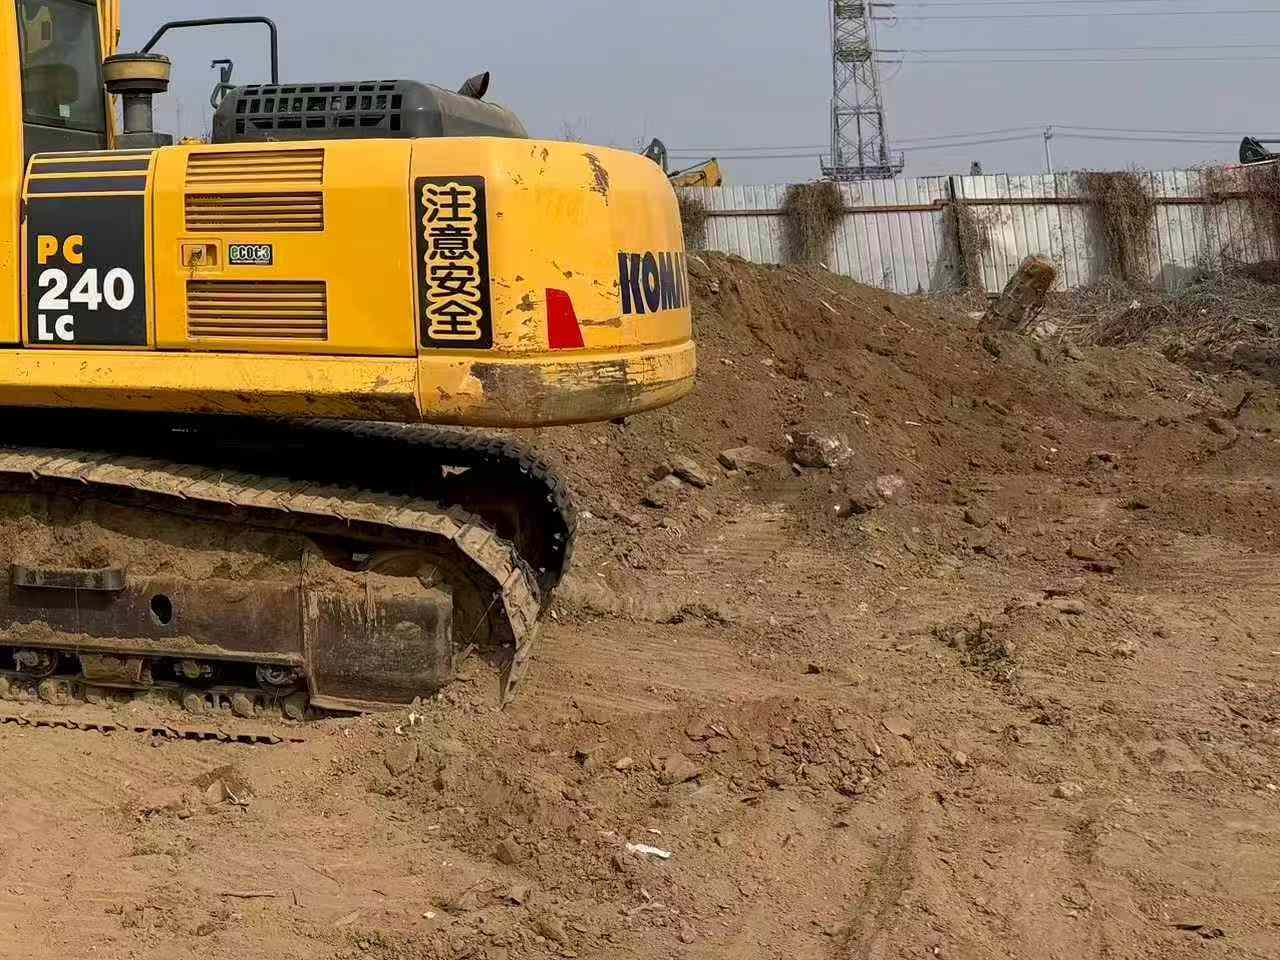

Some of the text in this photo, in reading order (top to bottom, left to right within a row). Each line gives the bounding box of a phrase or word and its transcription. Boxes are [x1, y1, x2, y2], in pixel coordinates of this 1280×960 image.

[37, 234, 83, 265] PC
[424, 185, 479, 337] 注意安全
[37, 267, 135, 311] 240
[37, 313, 75, 341] LC
